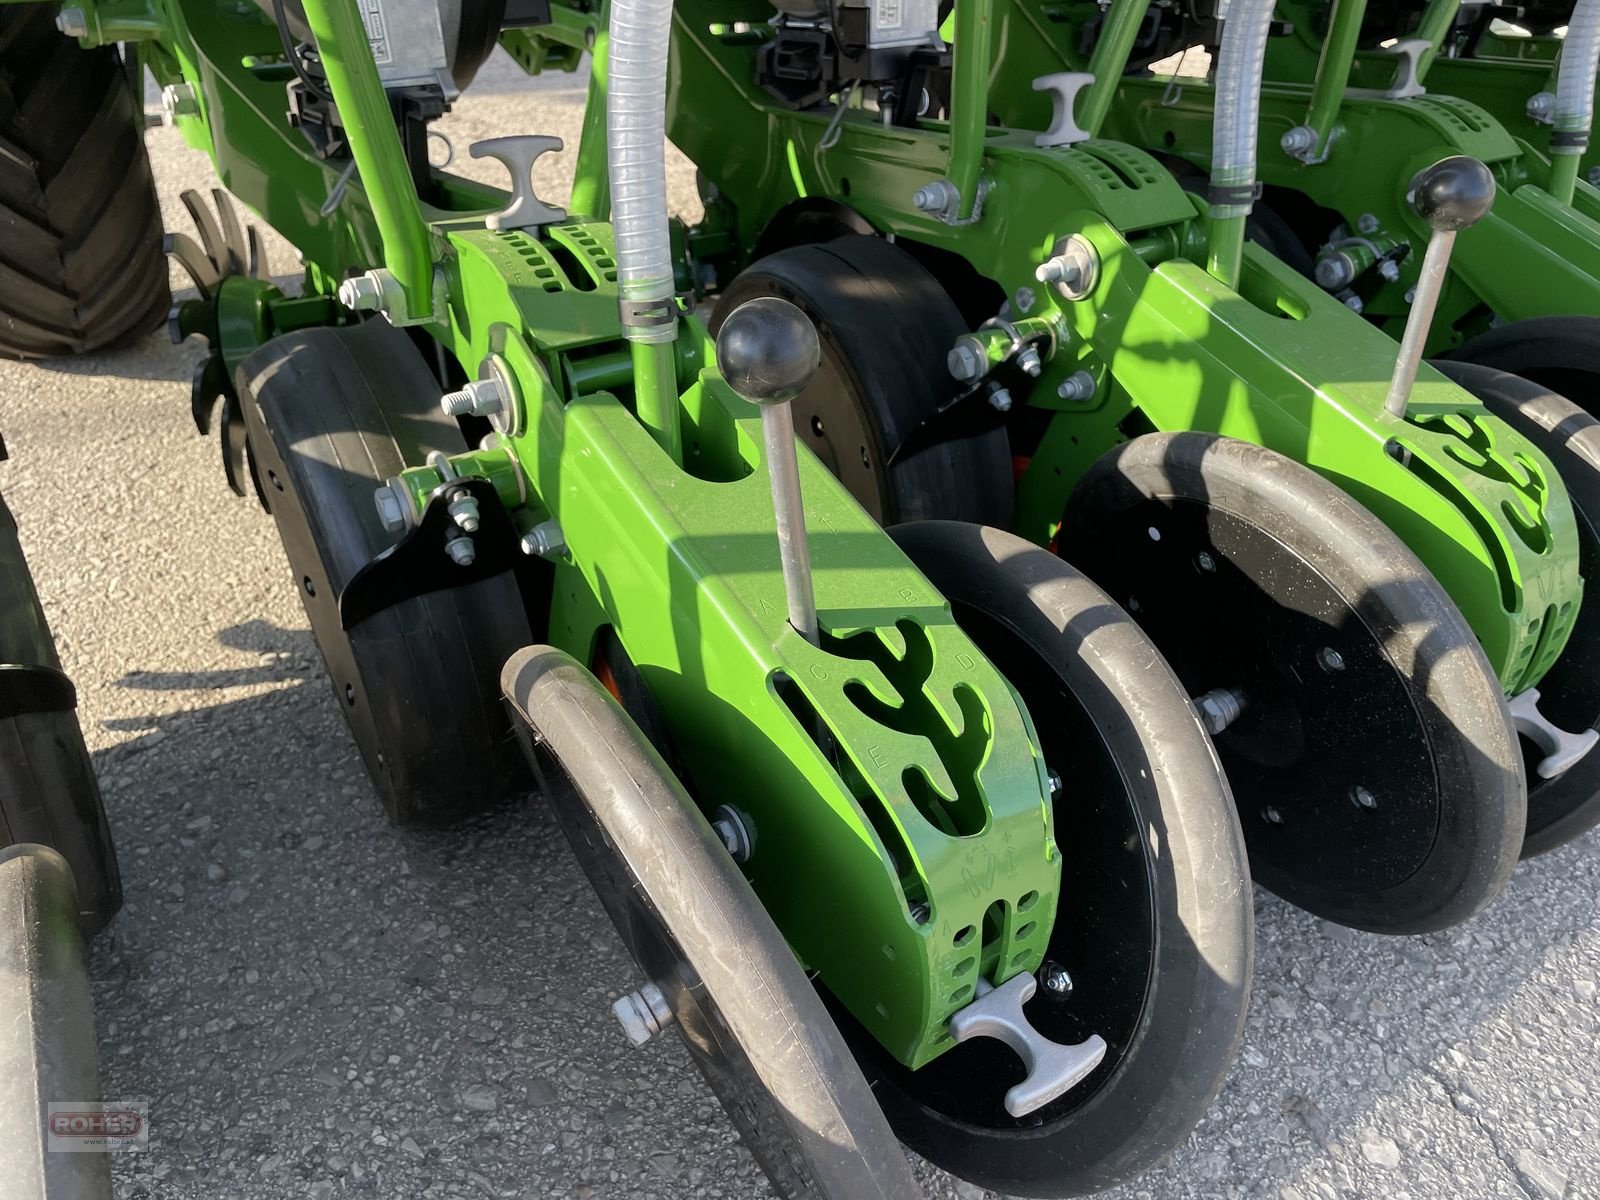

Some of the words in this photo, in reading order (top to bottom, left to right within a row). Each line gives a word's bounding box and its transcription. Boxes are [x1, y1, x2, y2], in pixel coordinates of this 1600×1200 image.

[898, 588, 918, 604] B
[759, 599, 777, 615] A
[956, 654, 976, 671] D
[809, 664, 829, 681] C
[867, 745, 889, 769] E
